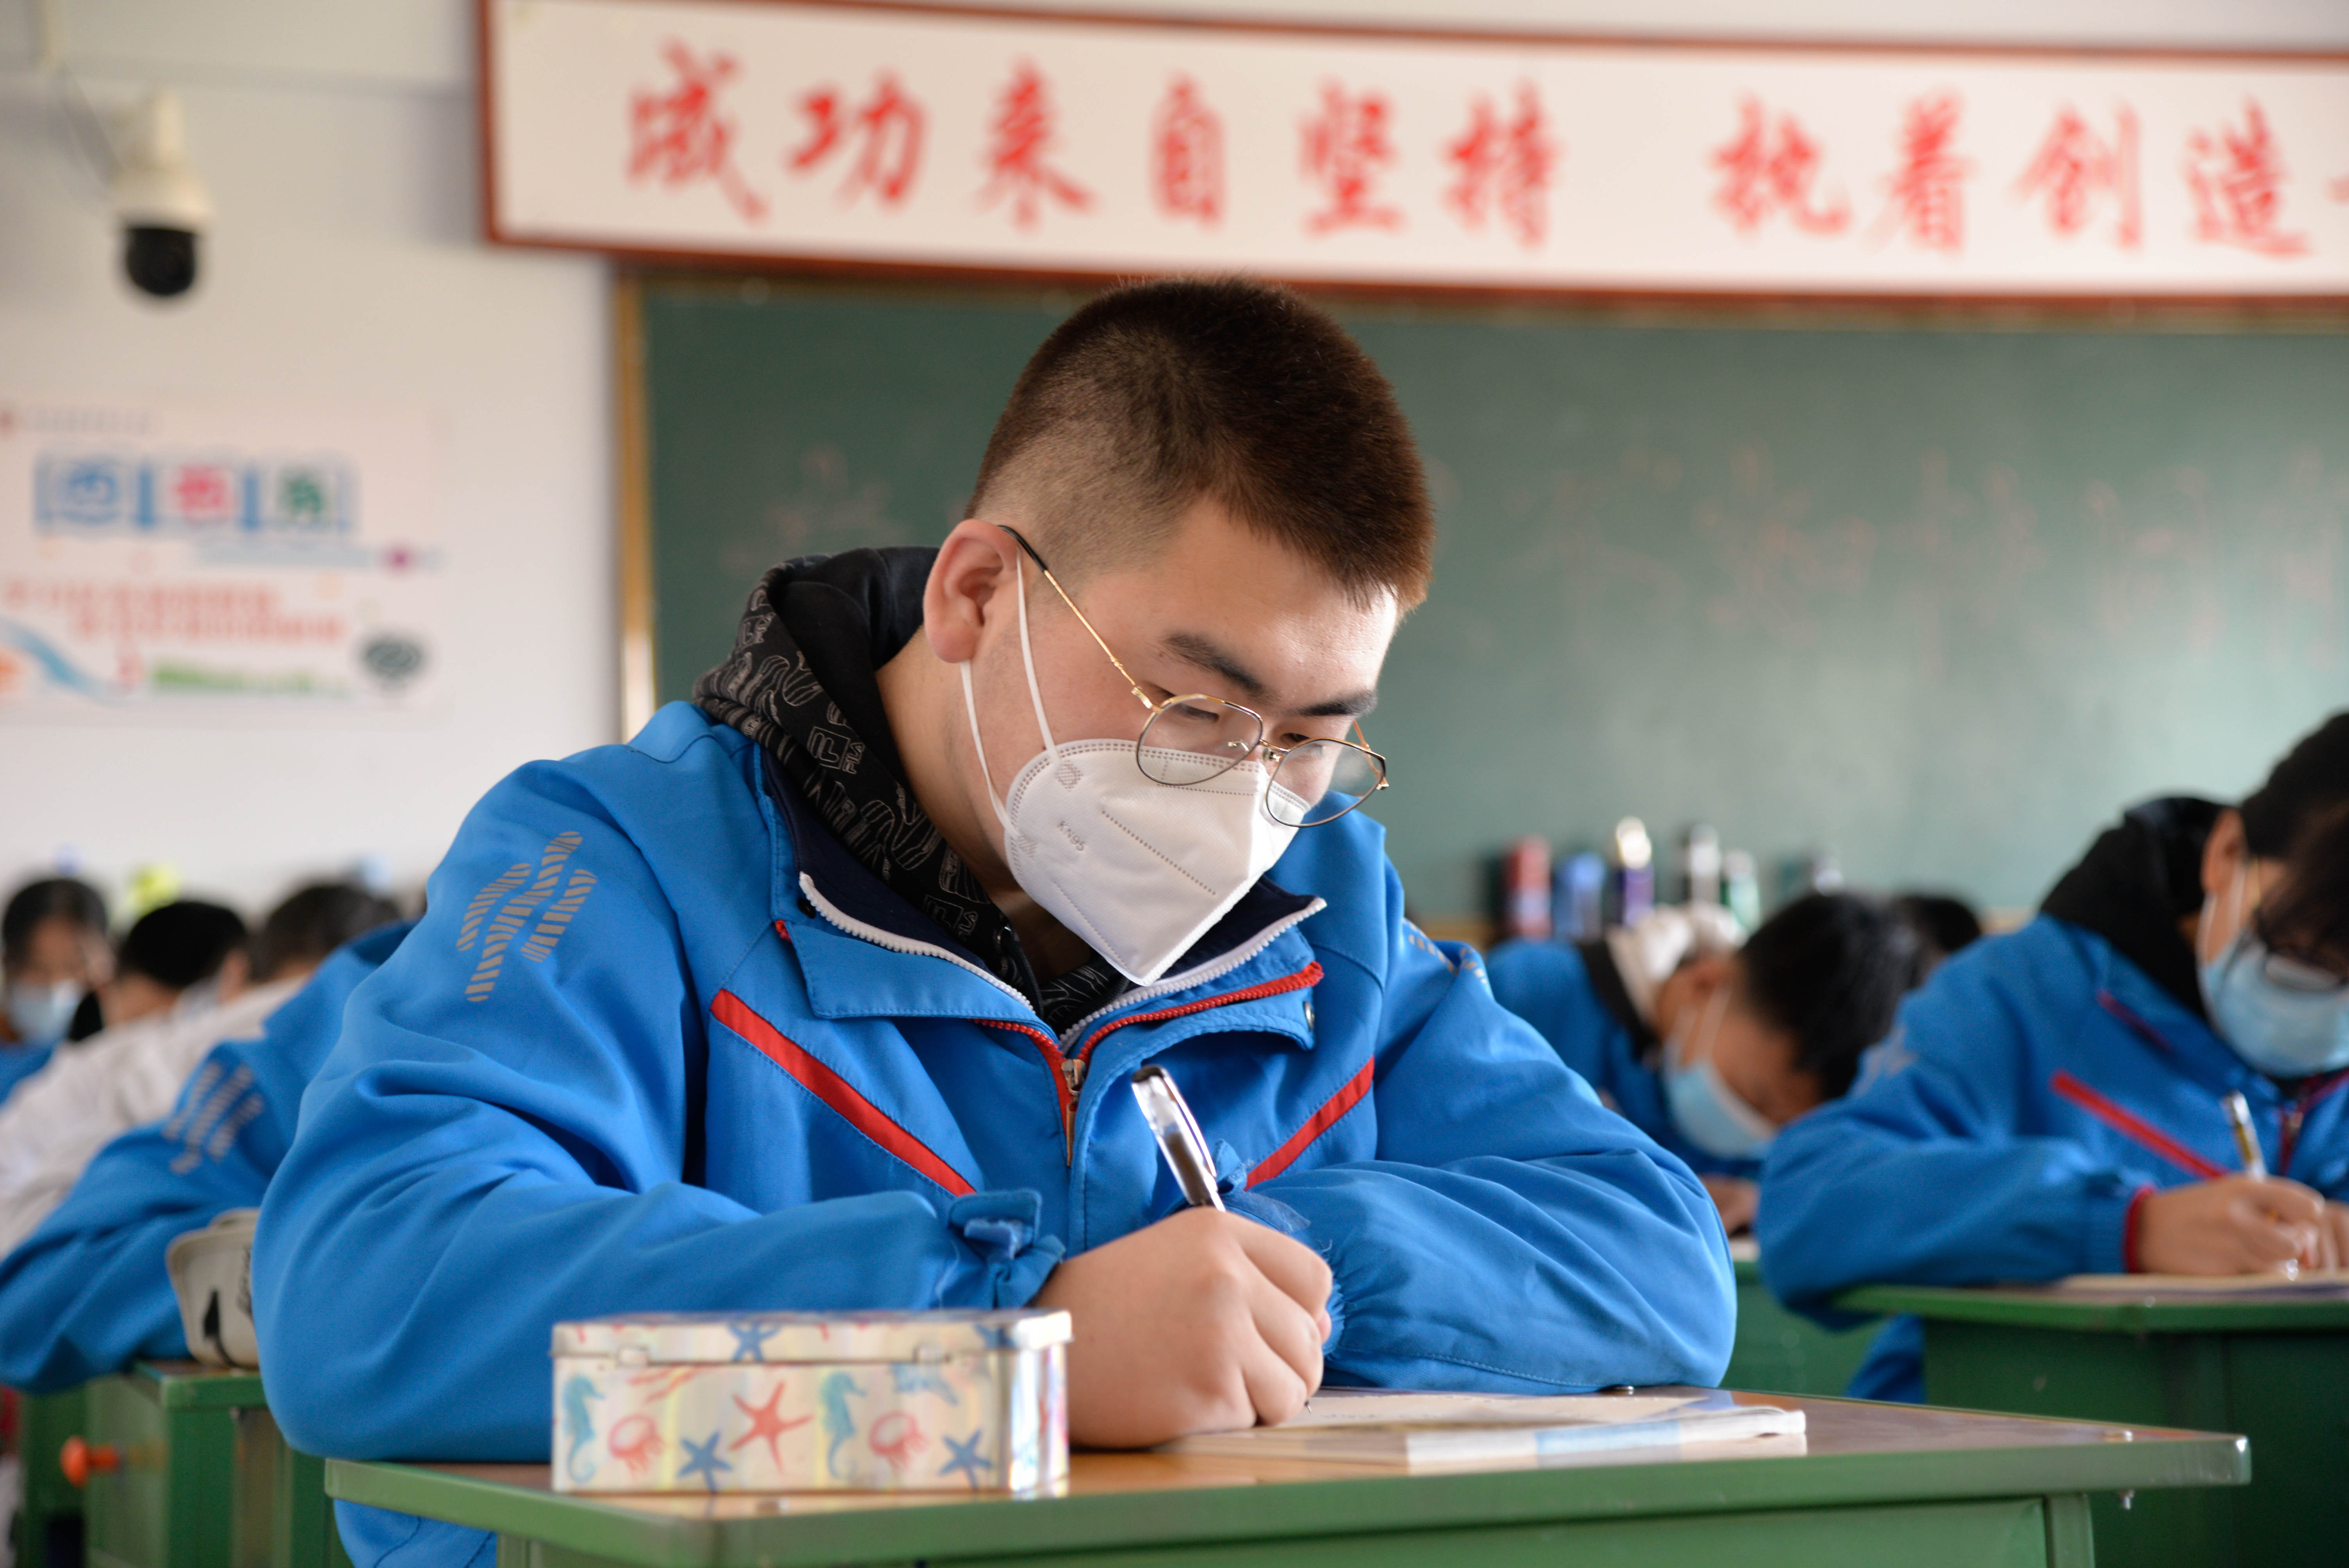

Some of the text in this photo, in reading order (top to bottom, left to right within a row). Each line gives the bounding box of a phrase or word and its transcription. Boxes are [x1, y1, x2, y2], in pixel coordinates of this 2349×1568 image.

[625, 39, 2349, 258] 成功来自坚持 执着创造
[842, 741, 866, 775] FILA
[1057, 820, 1085, 851] KN95
